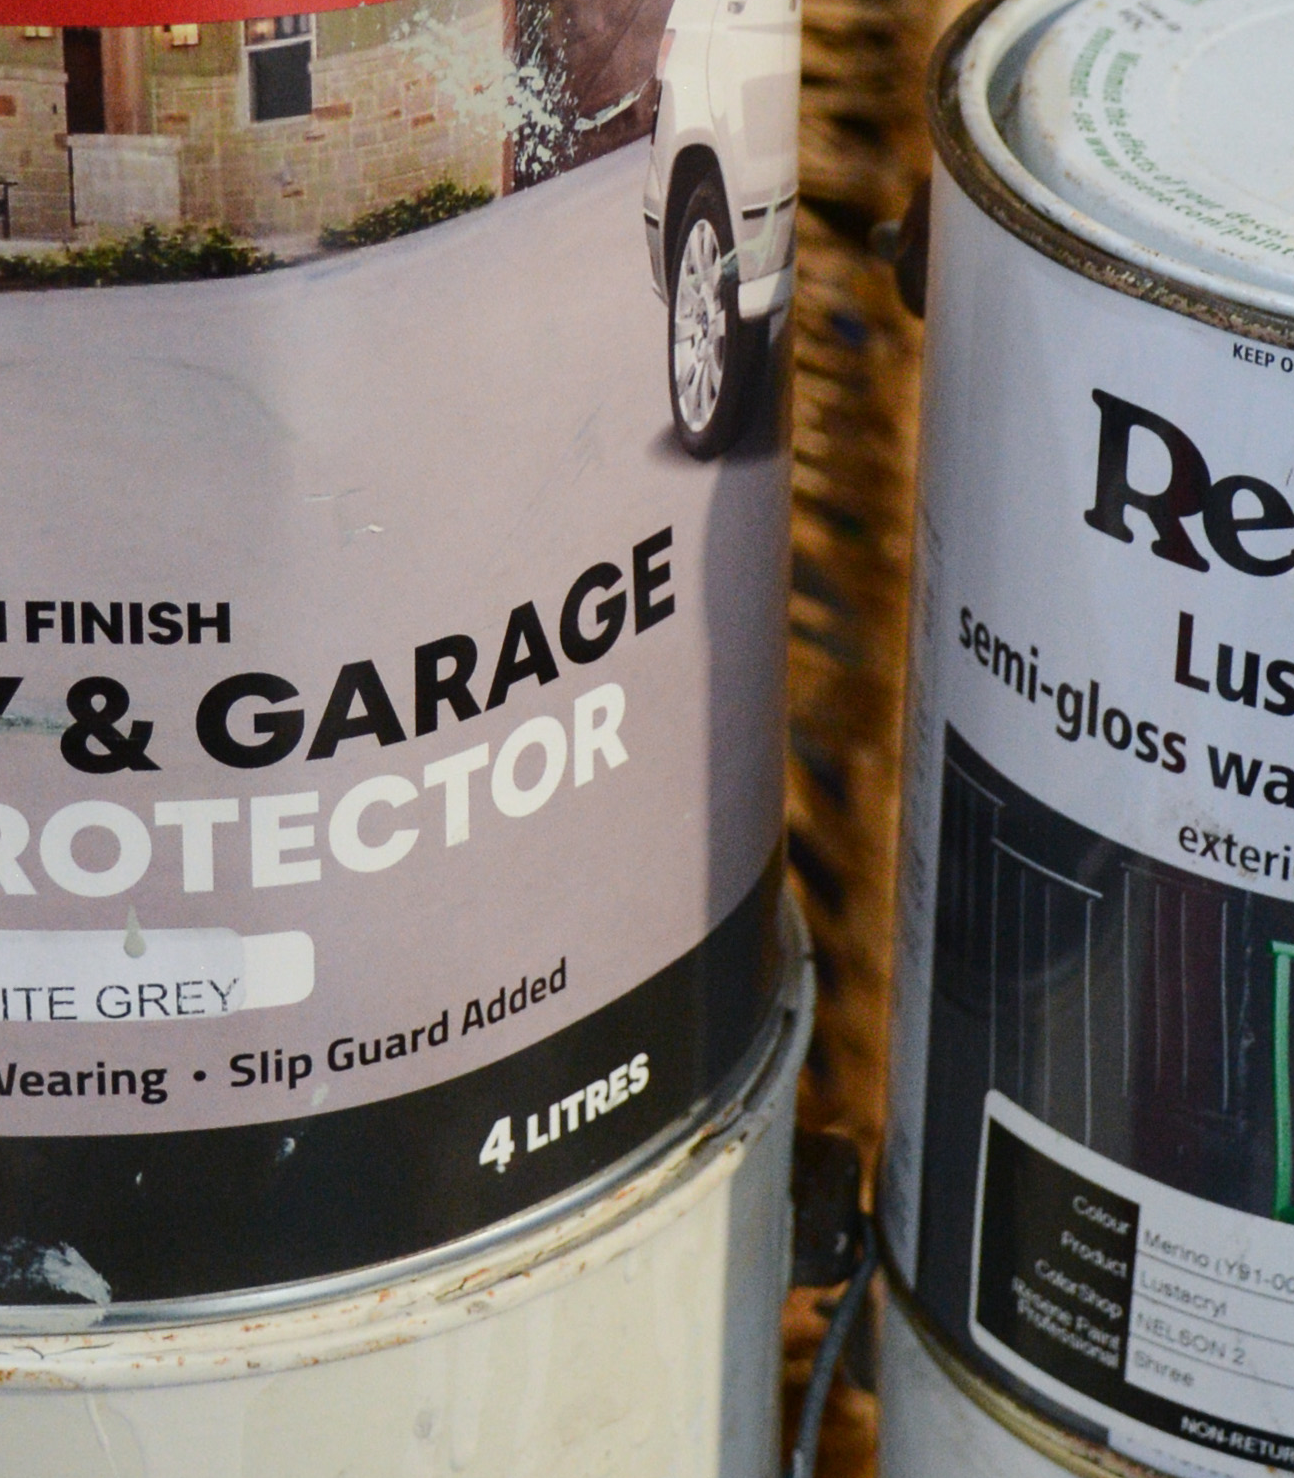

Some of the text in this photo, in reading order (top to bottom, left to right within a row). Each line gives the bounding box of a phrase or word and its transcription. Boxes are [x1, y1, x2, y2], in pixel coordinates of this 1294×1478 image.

[1231, 342, 1275, 370] KEEP
[25, 600, 232, 645] FINISH
[60, 675, 163, 774] &
[195, 524, 676, 770] GARAGE
[959, 605, 1188, 775] semi-gloss
[95, 976, 241, 1020] GREY
[229, 956, 568, 1090] Slip Guard Added
[478, 1052, 650, 1169] 4 LITRES
[1071, 1193, 1130, 1237] Colour
[1060, 1229, 1128, 1280] Product
[1143, 1229, 1211, 1269] Merino
[1139, 1266, 1228, 1318] Lustacryl
[1135, 1311, 1247, 1367] NELSON 2
